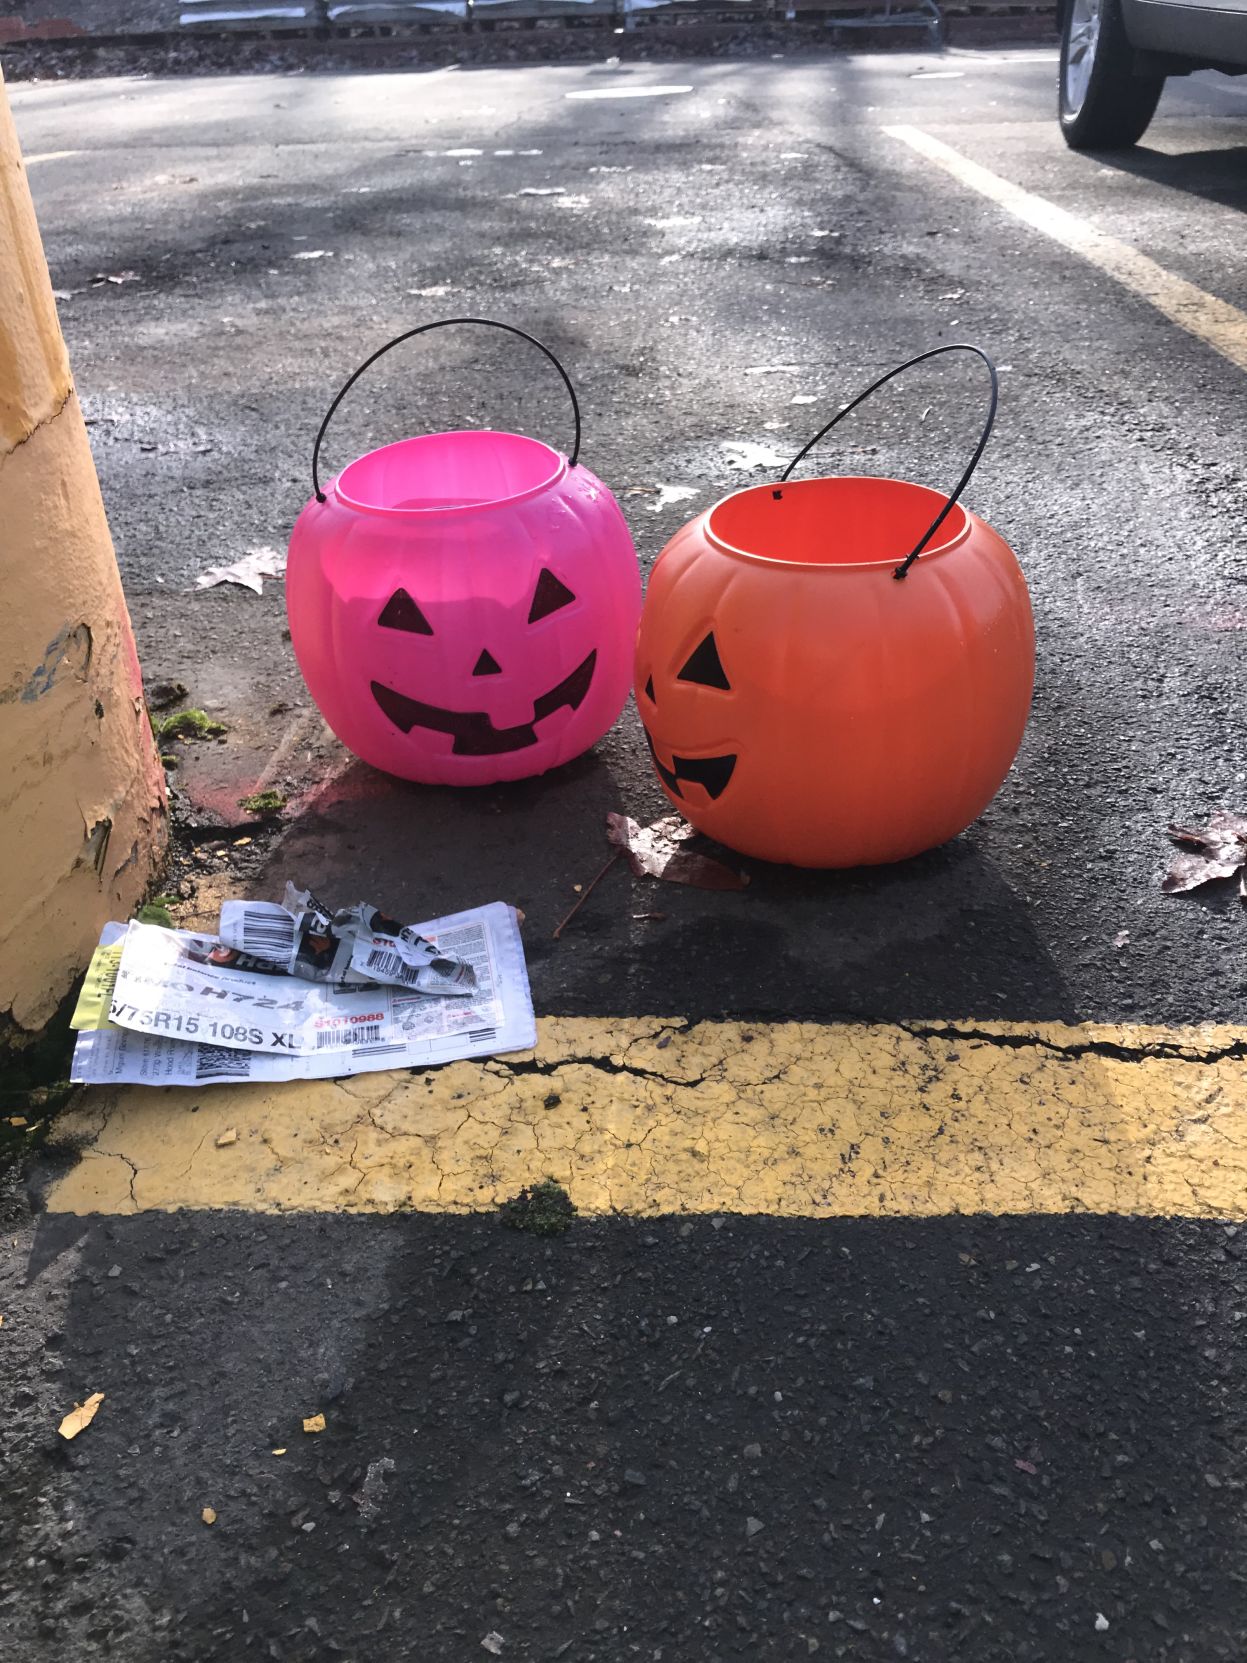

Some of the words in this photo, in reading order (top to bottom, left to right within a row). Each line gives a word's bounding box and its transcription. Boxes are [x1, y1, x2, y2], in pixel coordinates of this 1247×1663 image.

[200, 986, 304, 1011] H724
[209, 1022, 264, 1045] 108S
[270, 1032, 302, 1049] XL
